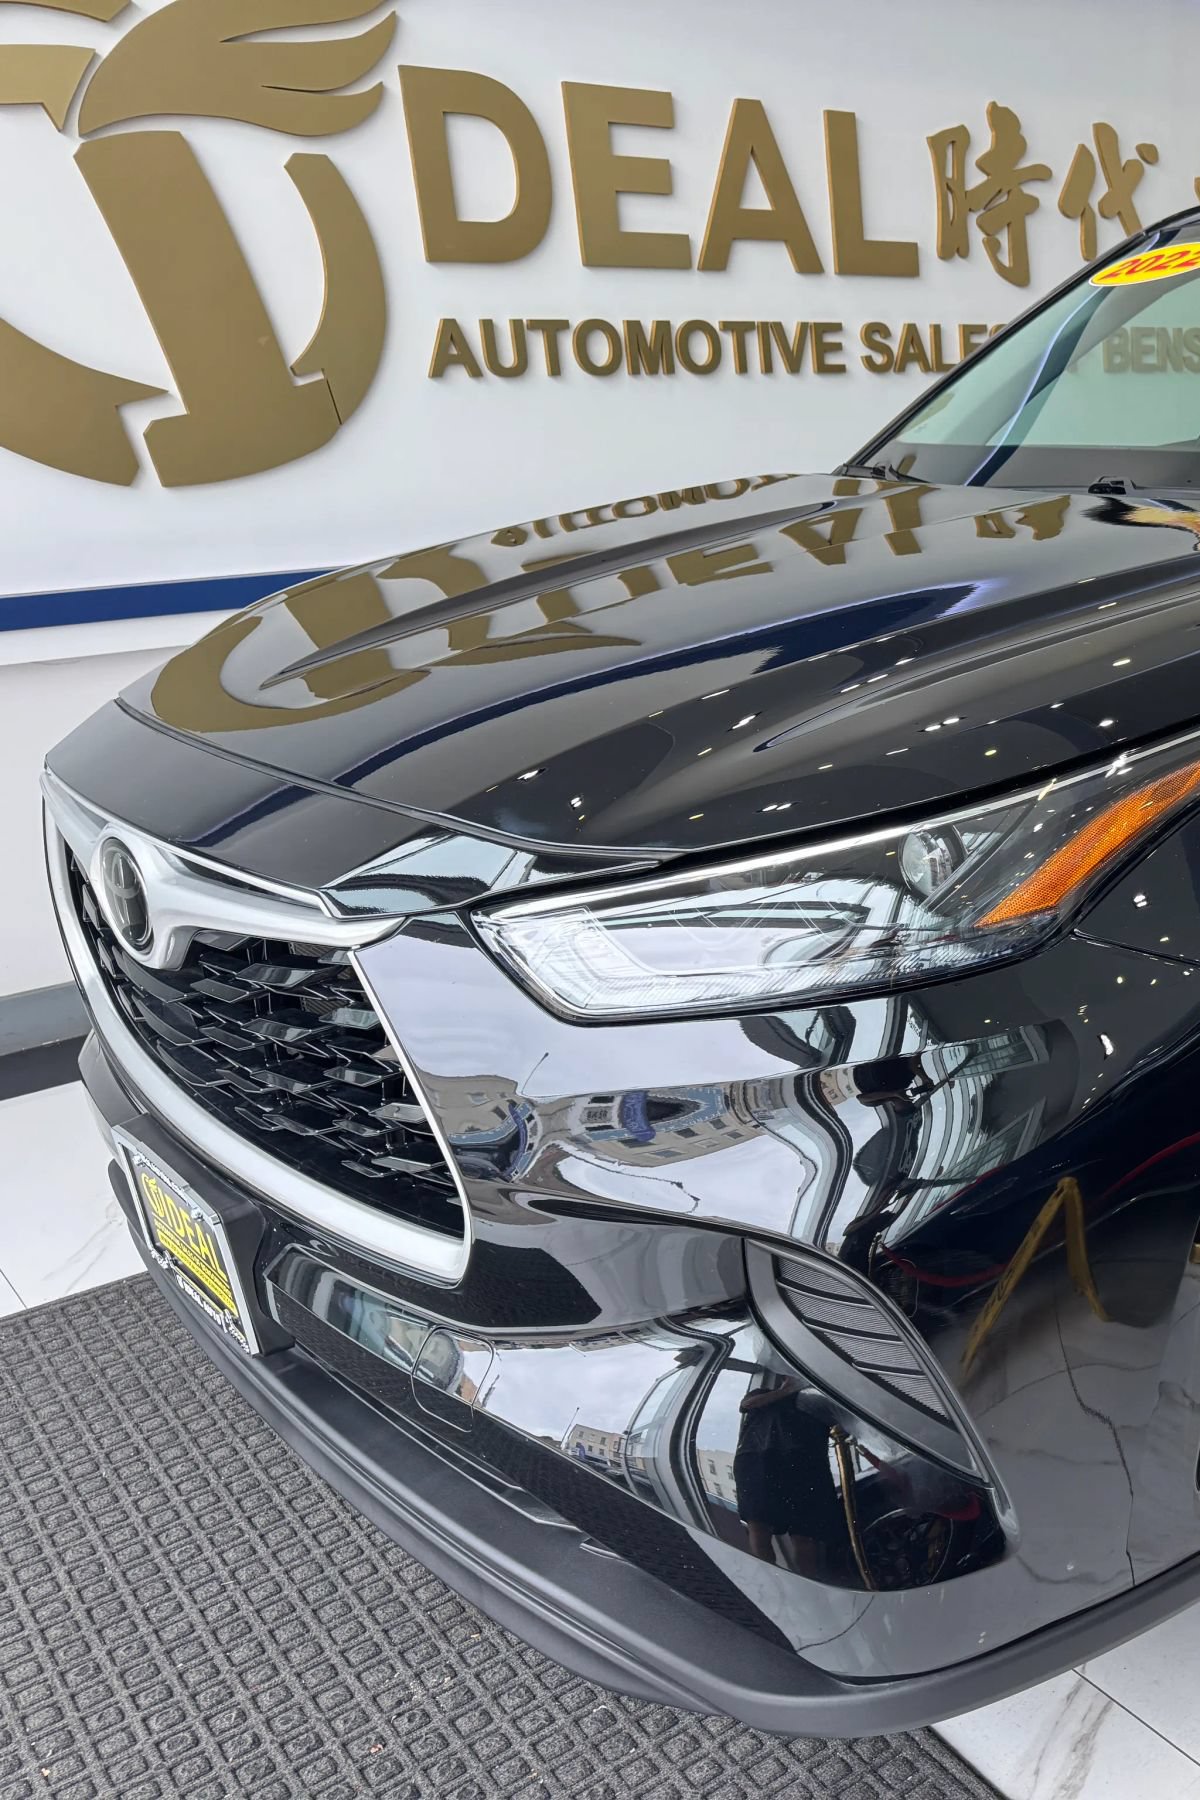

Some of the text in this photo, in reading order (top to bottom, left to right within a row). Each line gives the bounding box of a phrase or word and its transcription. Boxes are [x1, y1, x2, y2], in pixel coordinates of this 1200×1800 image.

[428, 319, 846, 378] AUTOMOTIVE
[860, 321, 1008, 374] SALE
[157, 1186, 228, 1282] IDEAL
